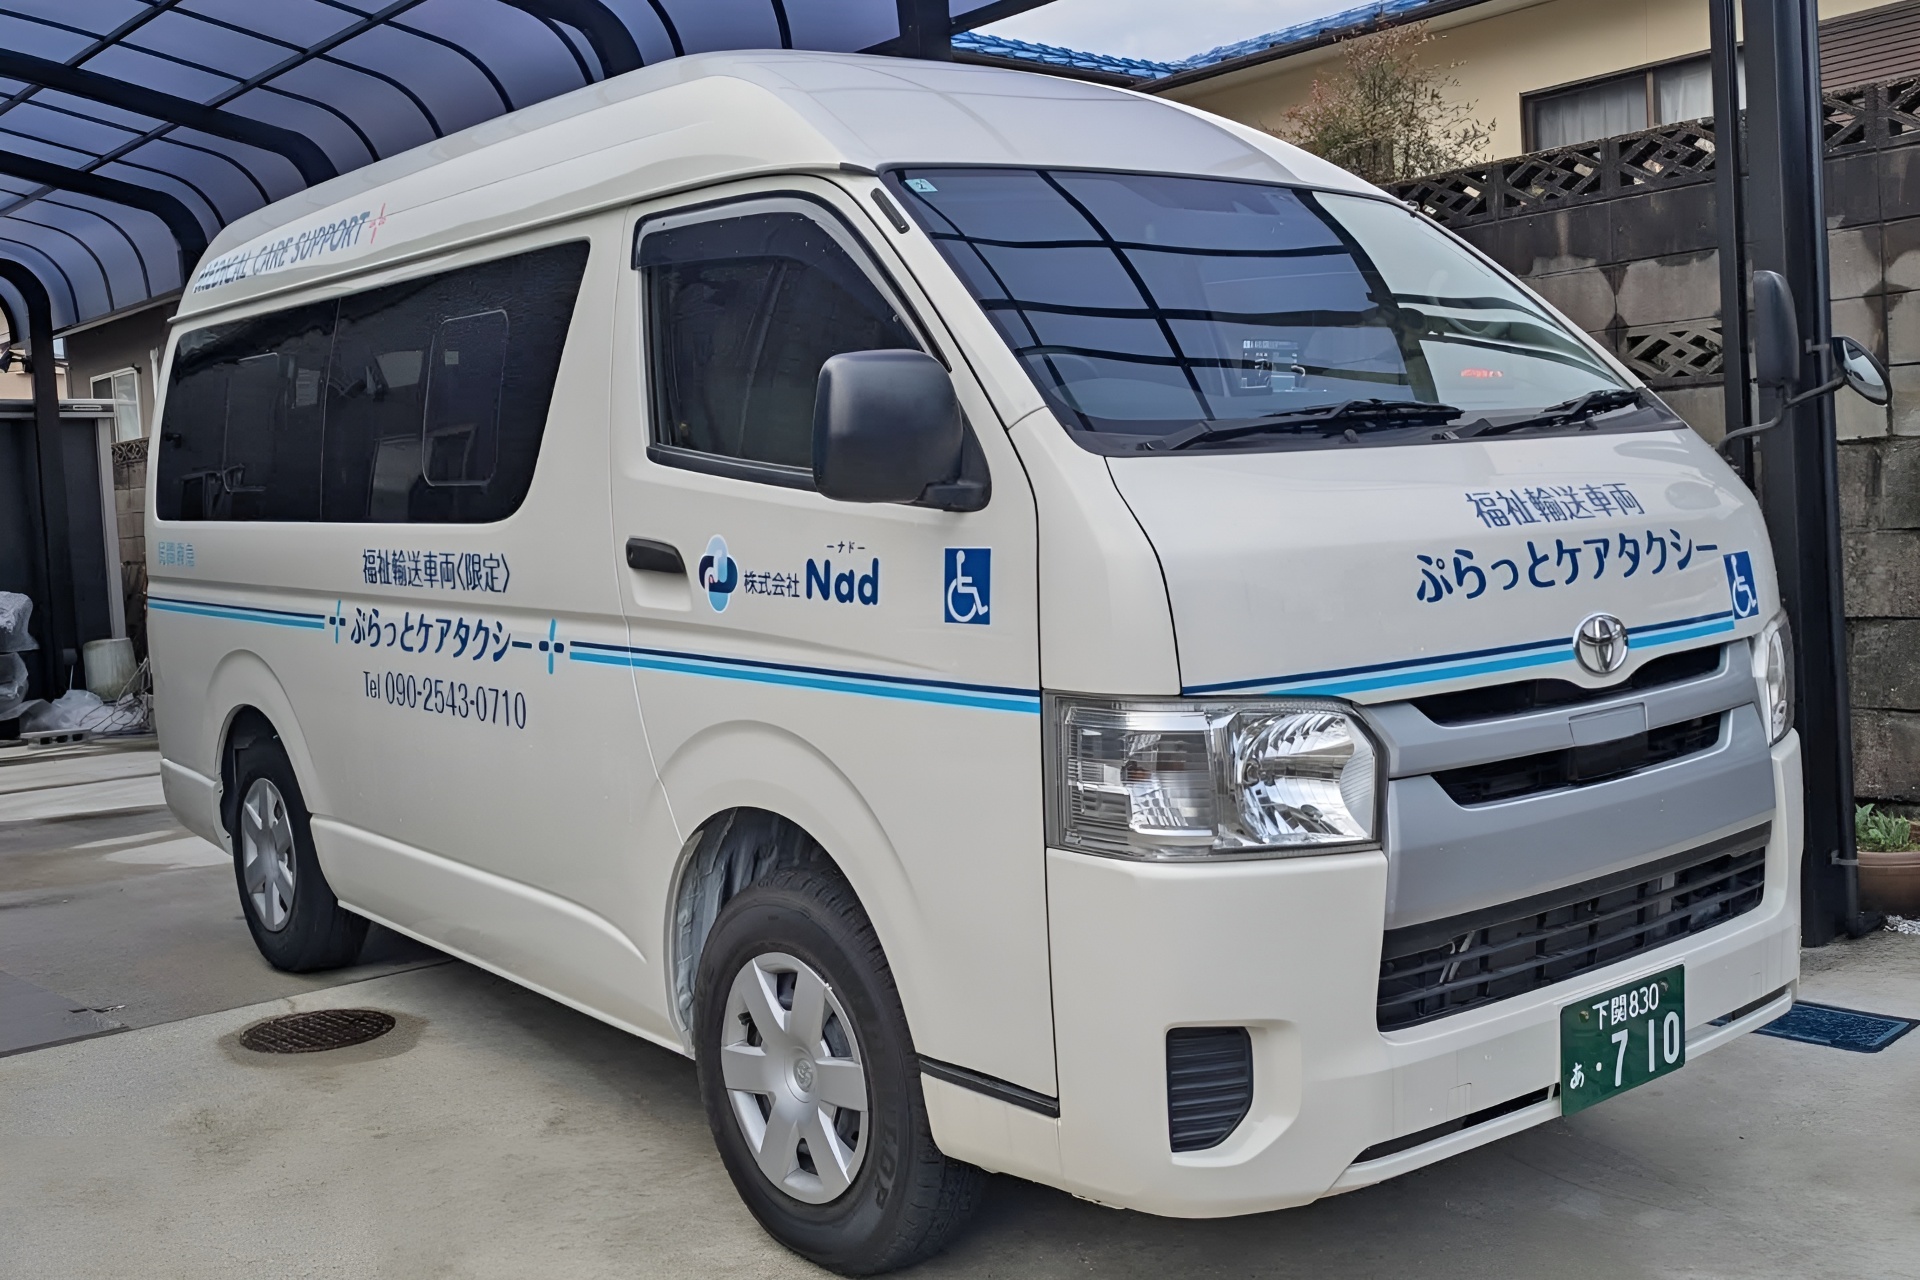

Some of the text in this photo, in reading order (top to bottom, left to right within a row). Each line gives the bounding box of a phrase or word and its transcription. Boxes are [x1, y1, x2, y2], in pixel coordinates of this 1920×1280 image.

[252, 236, 294, 276] CARE
[290, 211, 371, 264] SUPPORT
[1465, 482, 1645, 529] 福祉輸送車両
[743, 557, 879, 606] 株式会社 Nad
[1416, 528, 1718, 603] ぷらっとケアタクシー
[363, 671, 527, 730] Tel 090-2543-0710
[1569, 1062, 1585, 1090] あ
